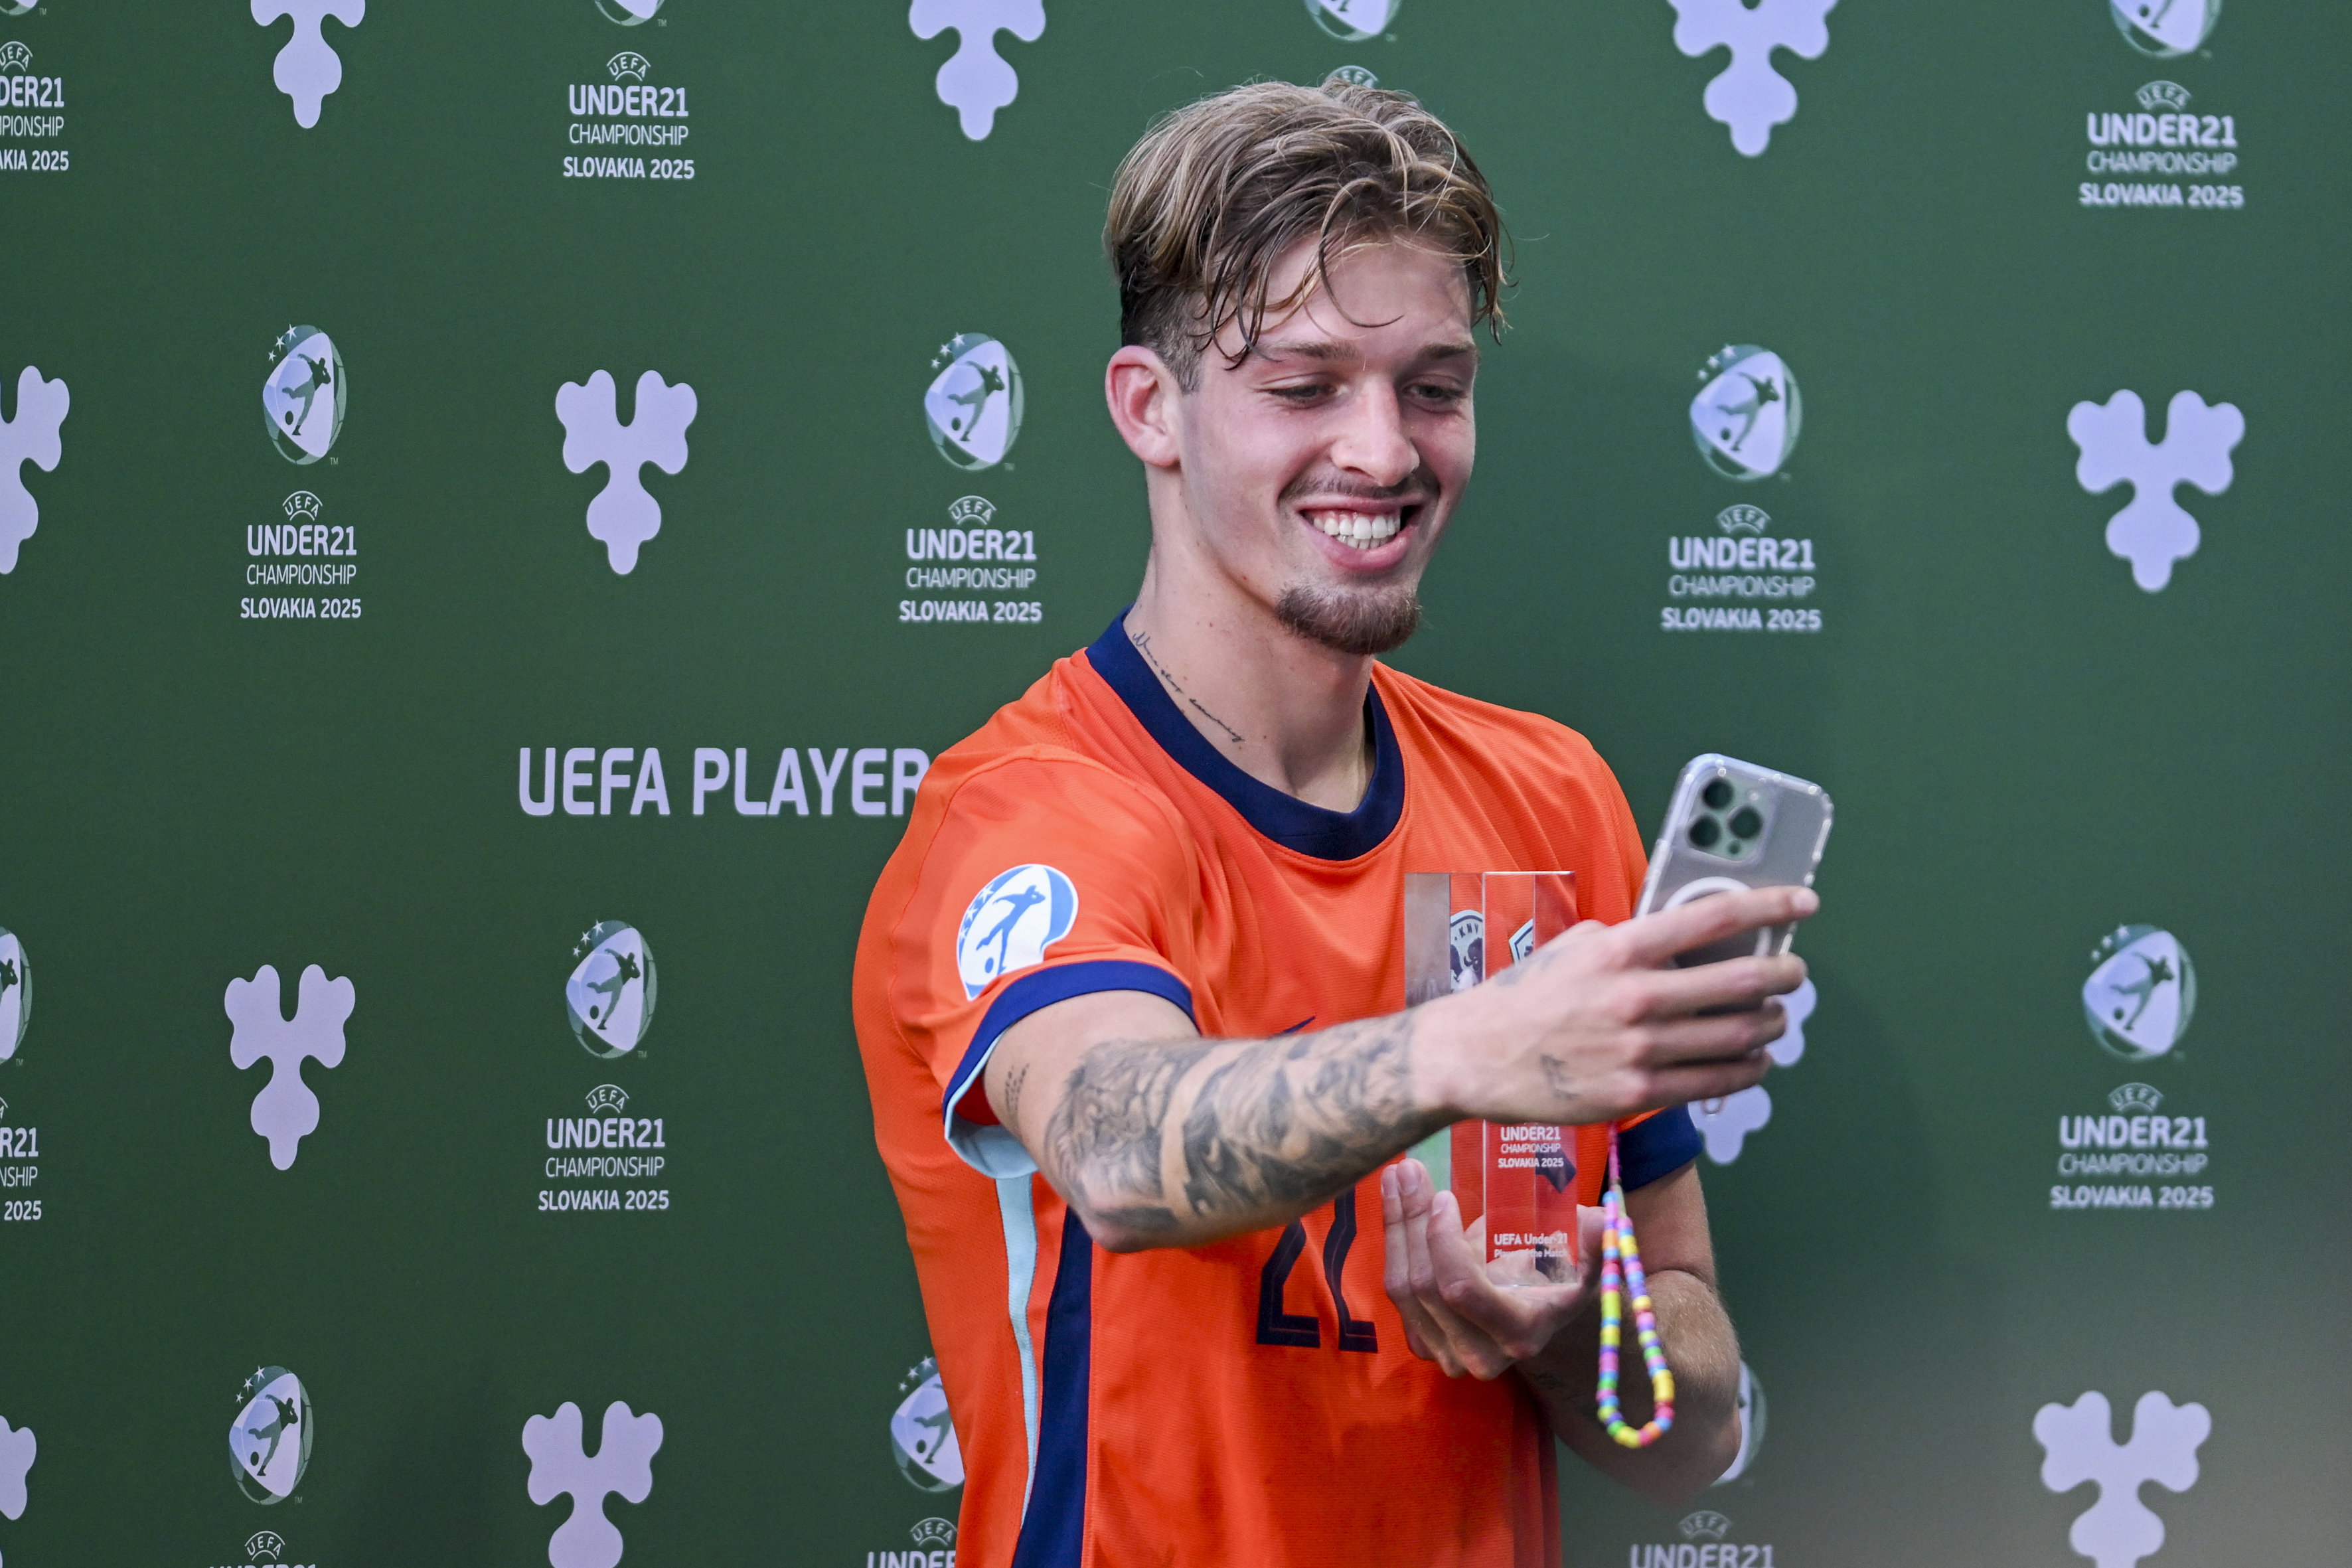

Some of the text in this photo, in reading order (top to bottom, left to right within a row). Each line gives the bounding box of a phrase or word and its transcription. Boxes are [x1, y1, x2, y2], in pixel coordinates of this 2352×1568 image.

[608, 51, 648, 76] UEFA
[570, 84, 688, 117] UNDER21
[2138, 86, 2189, 108] UEFA
[570, 123, 688, 145] CHAMPIONSHIP
[2088, 113, 2237, 147] UNDER21
[32, 150, 69, 171] 2025
[563, 157, 694, 179] SLOVAKIA 2025
[2087, 151, 2237, 174] CHAMPIONSHIP
[2079, 183, 2244, 208] SLOVAKIA 2025
[284, 497, 320, 516] UEFA
[951, 500, 992, 522] UEFA
[1720, 510, 1766, 530] UEFA
[248, 525, 356, 556] UNDER21
[907, 528, 1037, 562] UNDER21
[1670, 536, 1815, 571] UNDER21
[247, 564, 356, 585] CHAMPIONSHIP
[906, 568, 1036, 589] CHAMPIONSHIP
[1669, 574, 1816, 598] CHAMPIONSHIP
[240, 597, 361, 618] SLOVAKIA 2025
[900, 600, 1042, 623] SLOVAKIA 2025
[1662, 607, 1822, 631] SLOVAKIA 2025
[519, 747, 931, 817] UEFA PLAYER
[588, 1089, 626, 1109] UEFA
[547, 1118, 665, 1149] UNDER21
[1501, 1127, 1561, 1140] UNDER21
[2060, 1116, 2208, 1148] UNDER21
[1501, 1143, 1561, 1154] CHAMPIONSHIP
[546, 1156, 665, 1178] CHAMPIONSHIP
[1498, 1158, 1564, 1168] SLOVAKIA 2025
[2058, 1153, 2208, 1176] CHAMPIONSHIP
[538, 1190, 669, 1211] SLOVAKIA 2025
[2051, 1186, 2214, 1208] SLOVAKIA 2025
[4, 1200, 41, 1221] 2025
[1494, 1233, 1522, 1245] UEFA
[912, 1522, 954, 1541] UEFA
[247, 1535, 281, 1556] UEFA
[1630, 1543, 1774, 1568] UNDER21
